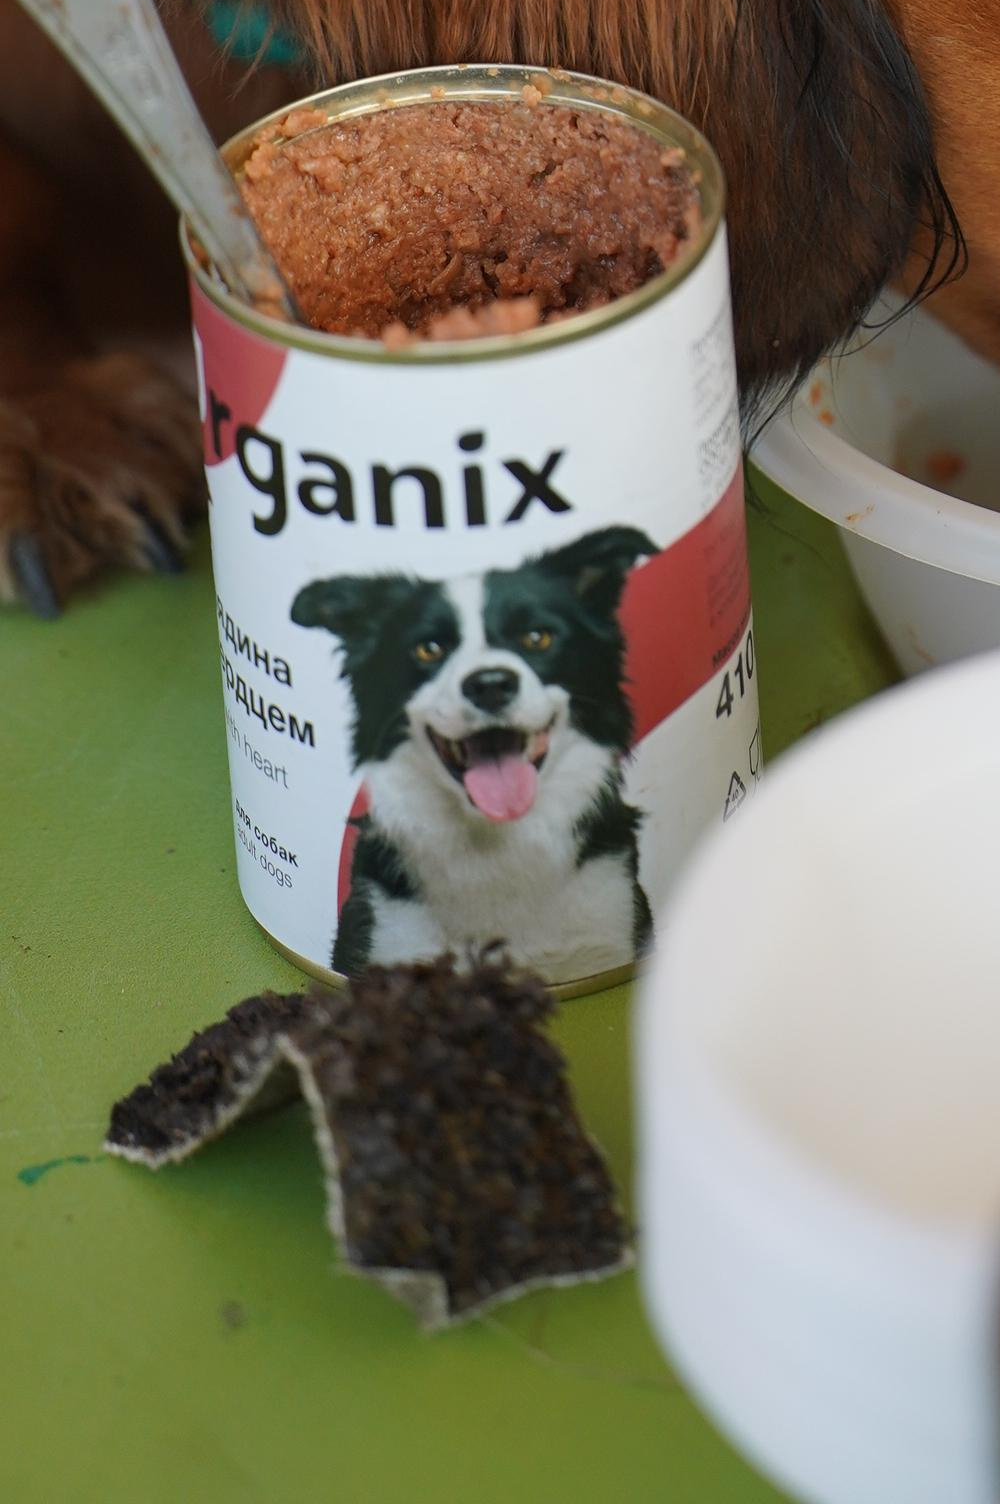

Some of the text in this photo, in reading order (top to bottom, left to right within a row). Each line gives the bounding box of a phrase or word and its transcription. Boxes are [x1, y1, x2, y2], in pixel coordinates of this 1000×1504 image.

[715, 628, 754, 720] 410
[243, 736, 289, 789] heart
[253, 825, 299, 868] собак
[259, 853, 293, 889] dogs
